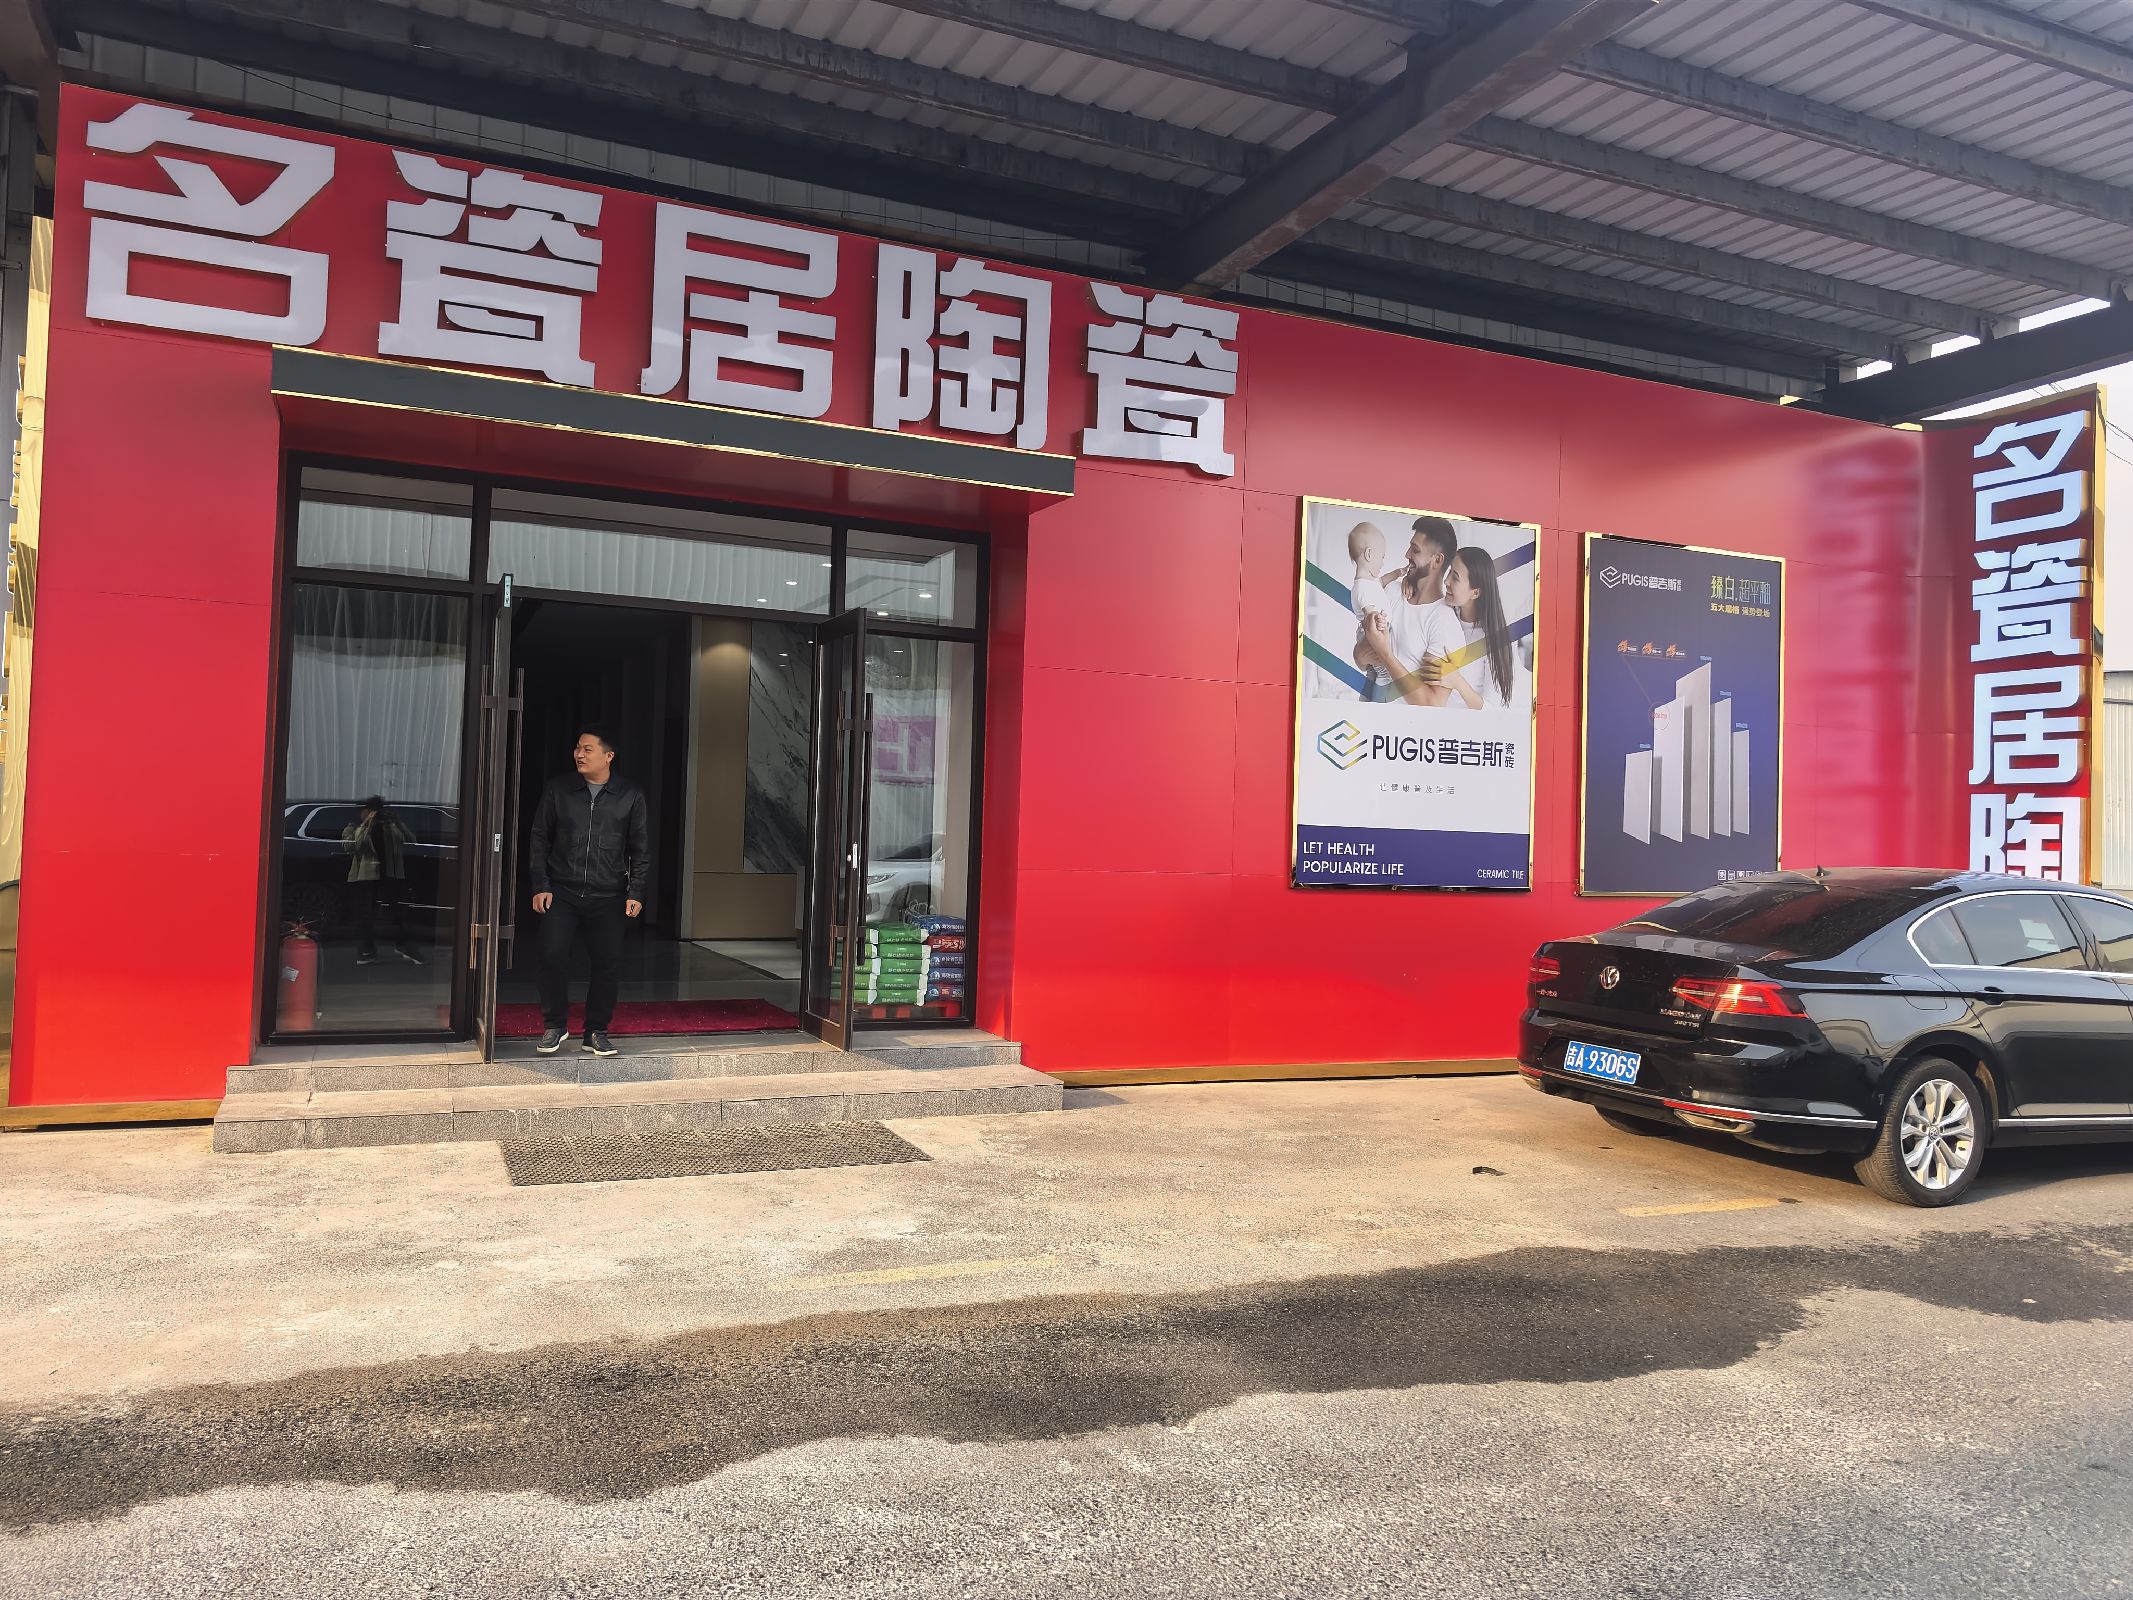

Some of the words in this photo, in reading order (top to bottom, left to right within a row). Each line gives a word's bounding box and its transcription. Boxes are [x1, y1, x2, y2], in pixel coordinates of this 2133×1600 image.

[84, 103, 1239, 477] 名瓷居陶瓷
[1622, 573, 1648, 587] PUGIS
[1372, 735, 1436, 764] PUGIS
[1438, 738, 1504, 768] 普吉斯
[1303, 841, 1323, 854] LET
[1327, 842, 1375, 856] HEALTH
[1303, 860, 1378, 875] POPULARIZE
[1381, 863, 1404, 876] LIFE
[1477, 868, 1510, 879] CERAMIC
[1511, 869, 1524, 880] TILE
